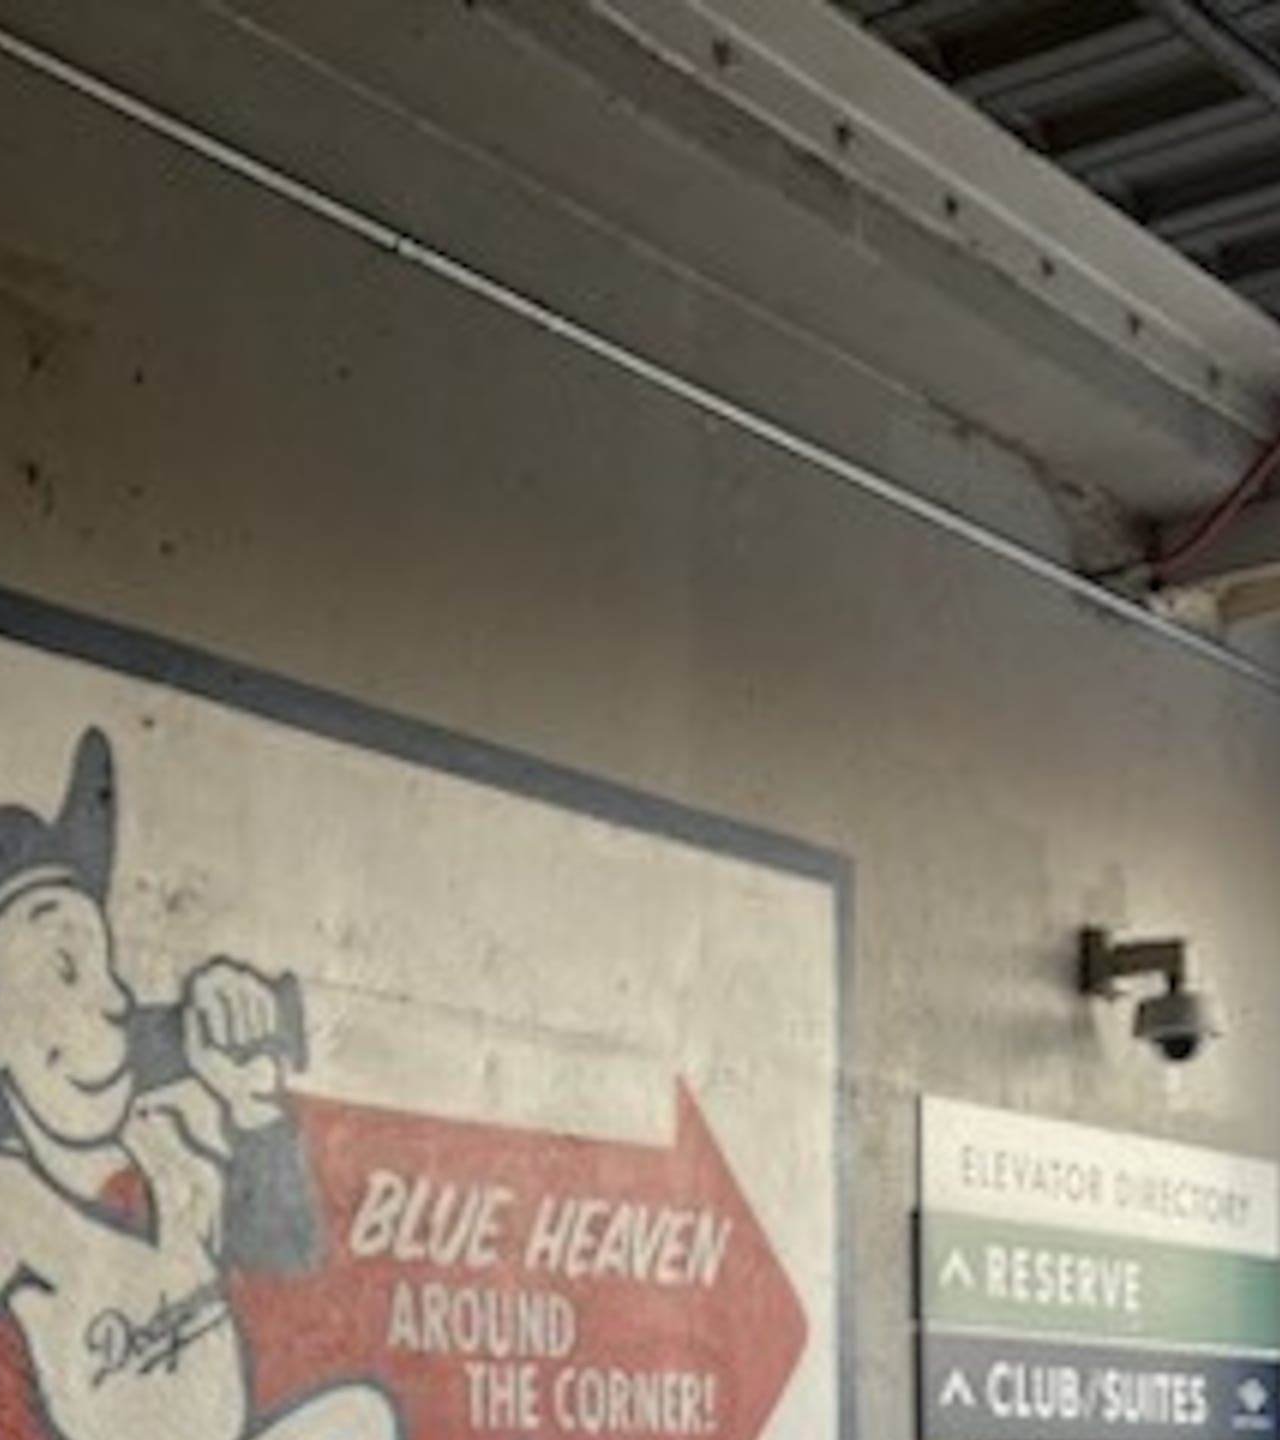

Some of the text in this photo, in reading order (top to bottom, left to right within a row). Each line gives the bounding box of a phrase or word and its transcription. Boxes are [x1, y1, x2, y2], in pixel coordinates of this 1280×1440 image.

[961, 1145, 1253, 1228] ELEVATOR DIRECTORY
[350, 1168, 732, 1287] BLUE HEAVEN
[985, 1244, 1141, 1313] RESERVE
[386, 1281, 578, 1357] AROUND
[466, 1360, 720, 1434] THE CORNER!
[986, 1360, 1209, 1426] CLUB/SUITES
